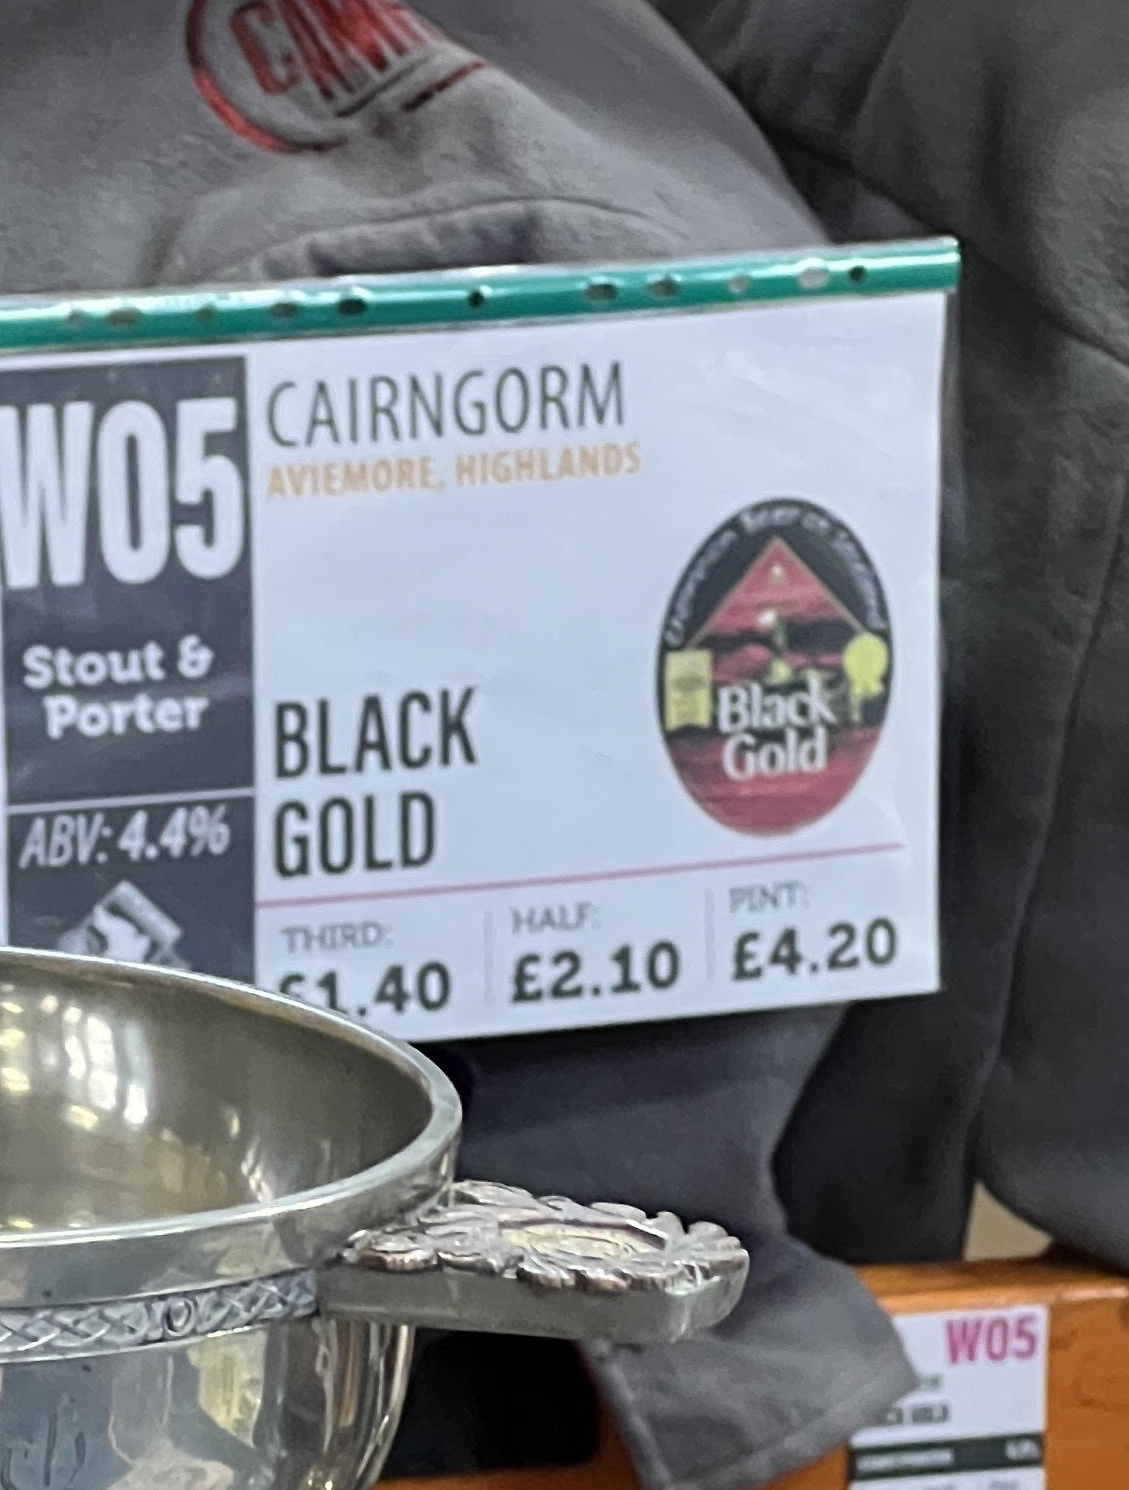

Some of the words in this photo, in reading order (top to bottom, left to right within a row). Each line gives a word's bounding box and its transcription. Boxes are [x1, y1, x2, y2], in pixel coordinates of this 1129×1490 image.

[266, 361, 624, 448] CAIRNGORM
[266, 455, 445, 498] AVIEMORE,
[454, 441, 641, 486] HIGHLANDS
[23, 640, 166, 689] Stout
[177, 633, 214, 678] &
[43, 693, 209, 740] Porter
[718, 668, 837, 733] Black
[276, 686, 477, 779] BLACK
[723, 724, 827, 781] Gold
[274, 791, 435, 878] GOLD
[510, 901, 602, 935] HALF:
[729, 879, 811, 913] PINT:
[280, 920, 395, 953] THIRD:
[731, 916, 898, 982] £4.20
[512, 939, 681, 1004] £2.10
[946, 1315, 1037, 1365] W05
